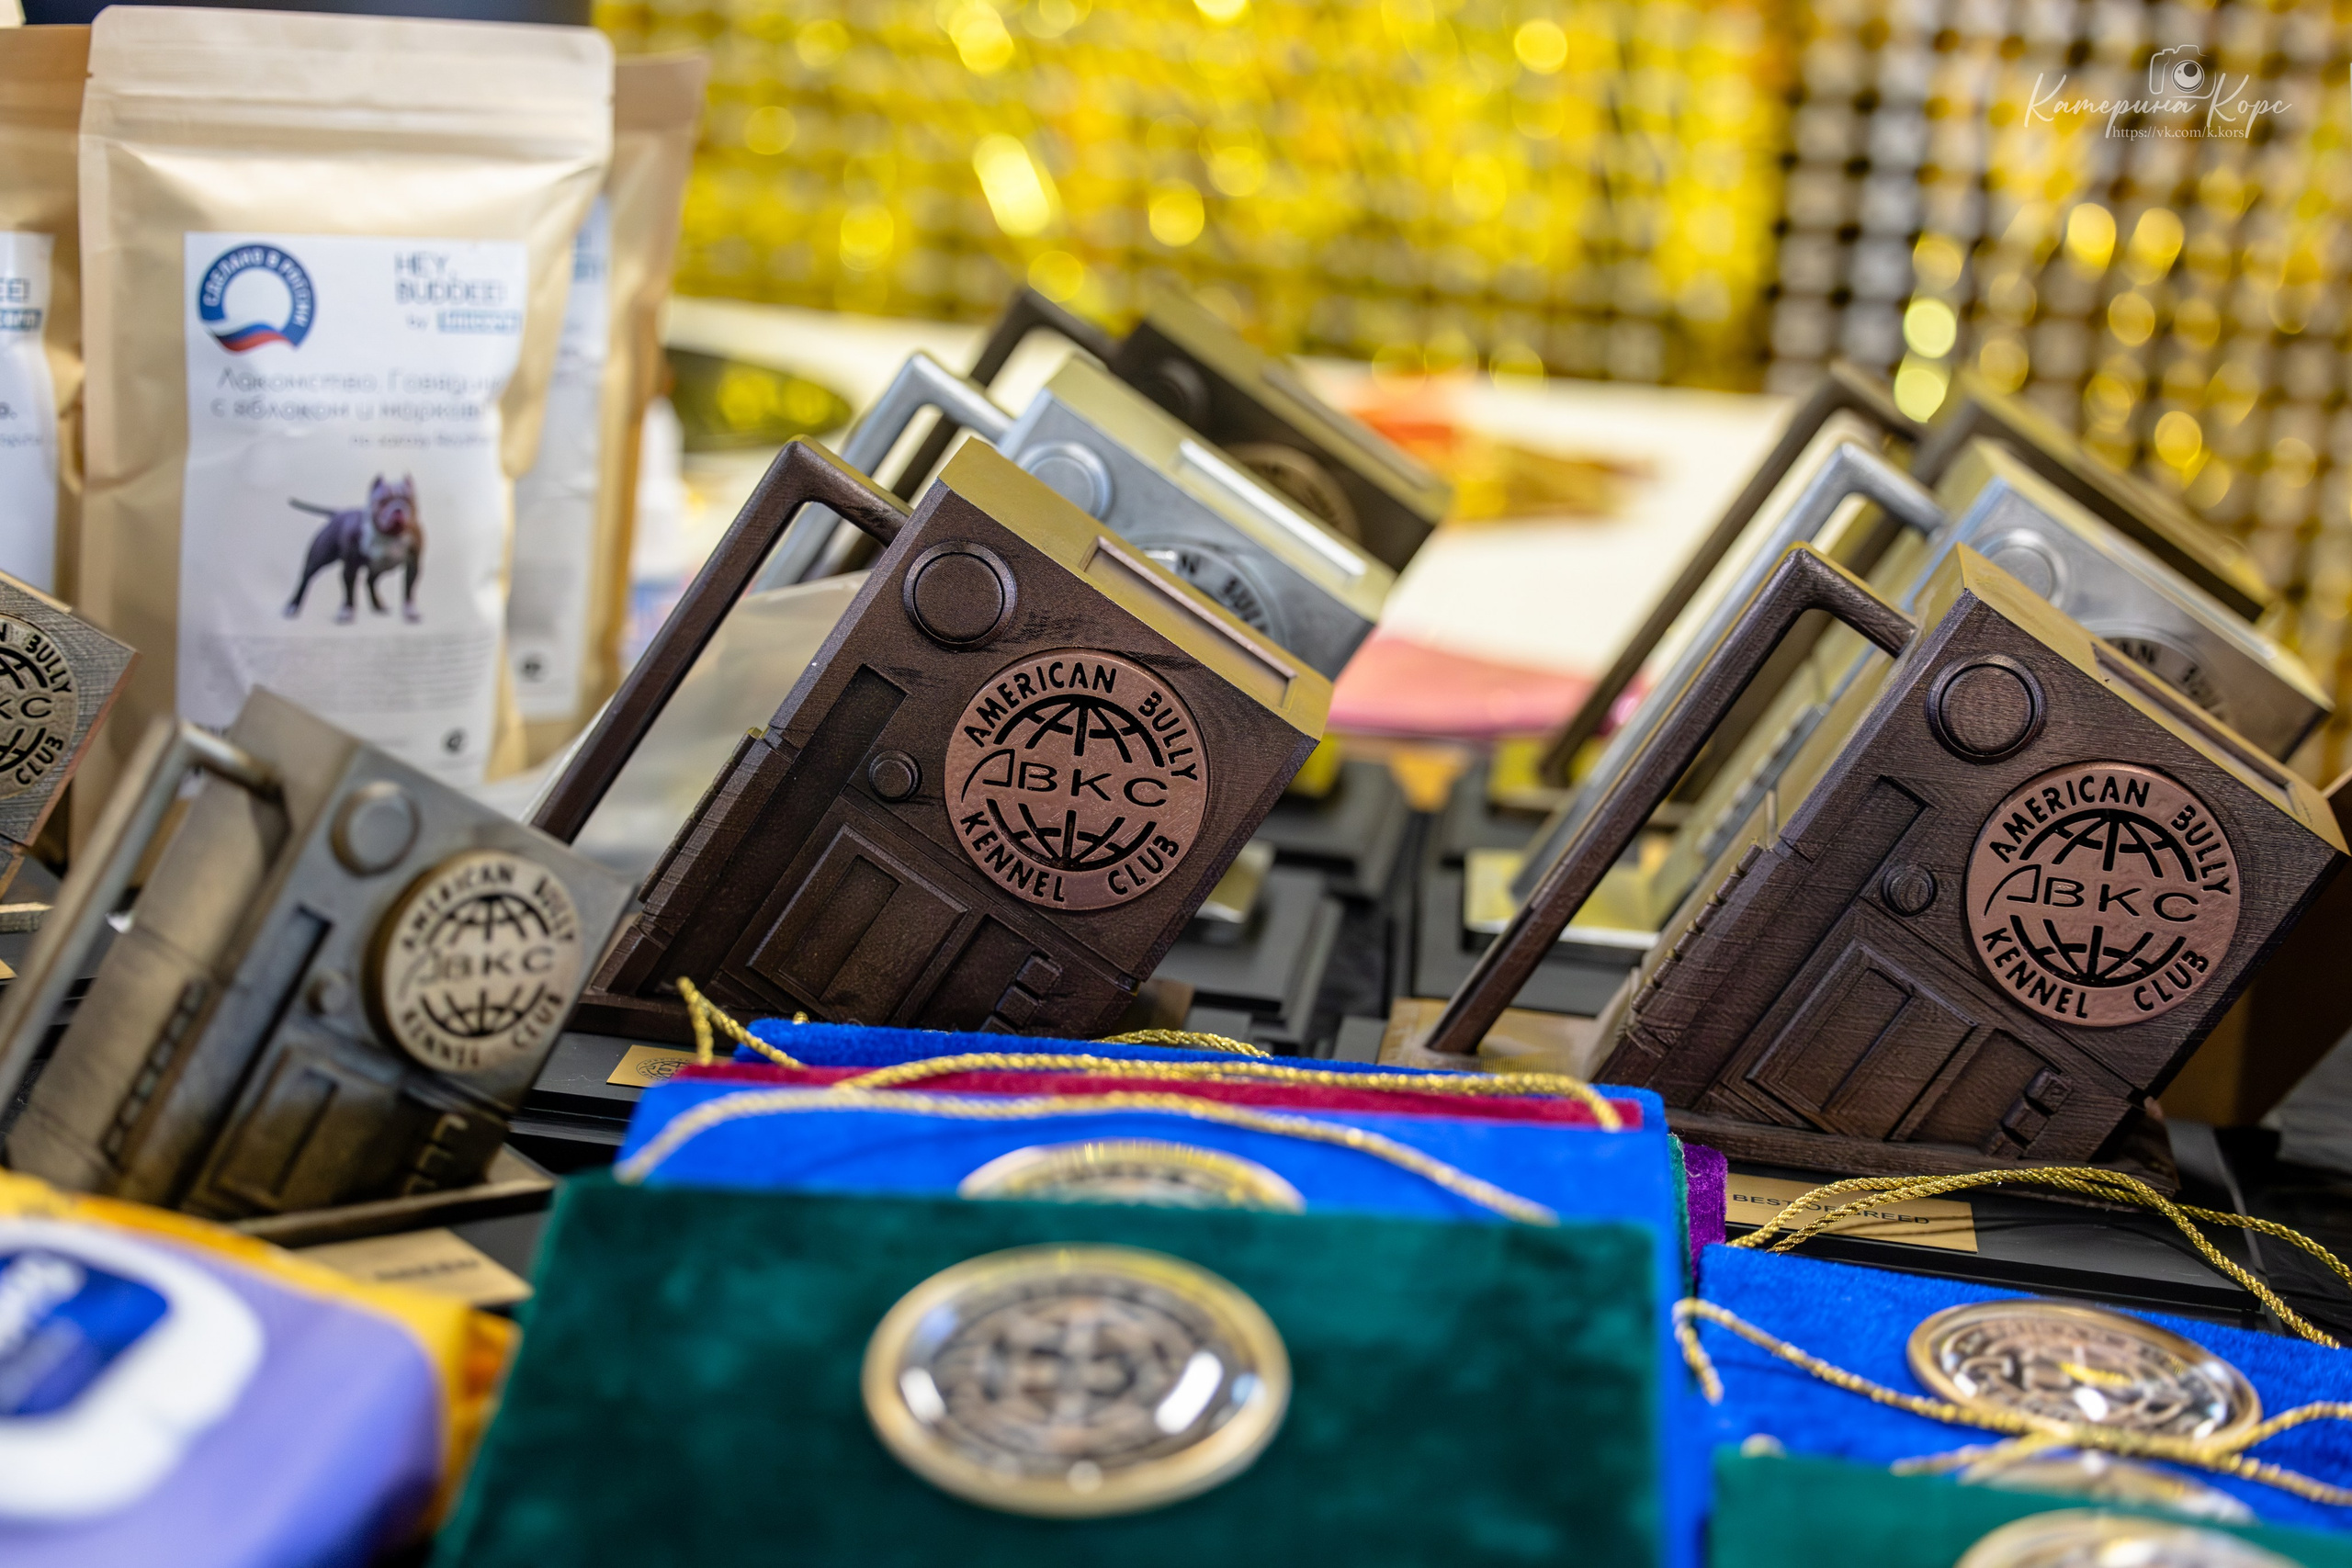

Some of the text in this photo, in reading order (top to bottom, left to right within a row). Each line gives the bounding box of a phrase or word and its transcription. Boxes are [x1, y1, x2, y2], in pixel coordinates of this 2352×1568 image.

[26, 635, 72, 693] BULLY
[16, 736, 63, 784] CLUB
[964, 661, 1198, 781] AMERICAN BULLY
[960, 810, 1180, 902] KENNEL CLUB
[1989, 775, 2232, 895] AMERICAN BULLY
[1982, 927, 2210, 1019] KENNEL CLUB
[1853, 1210, 1930, 1224] REED
